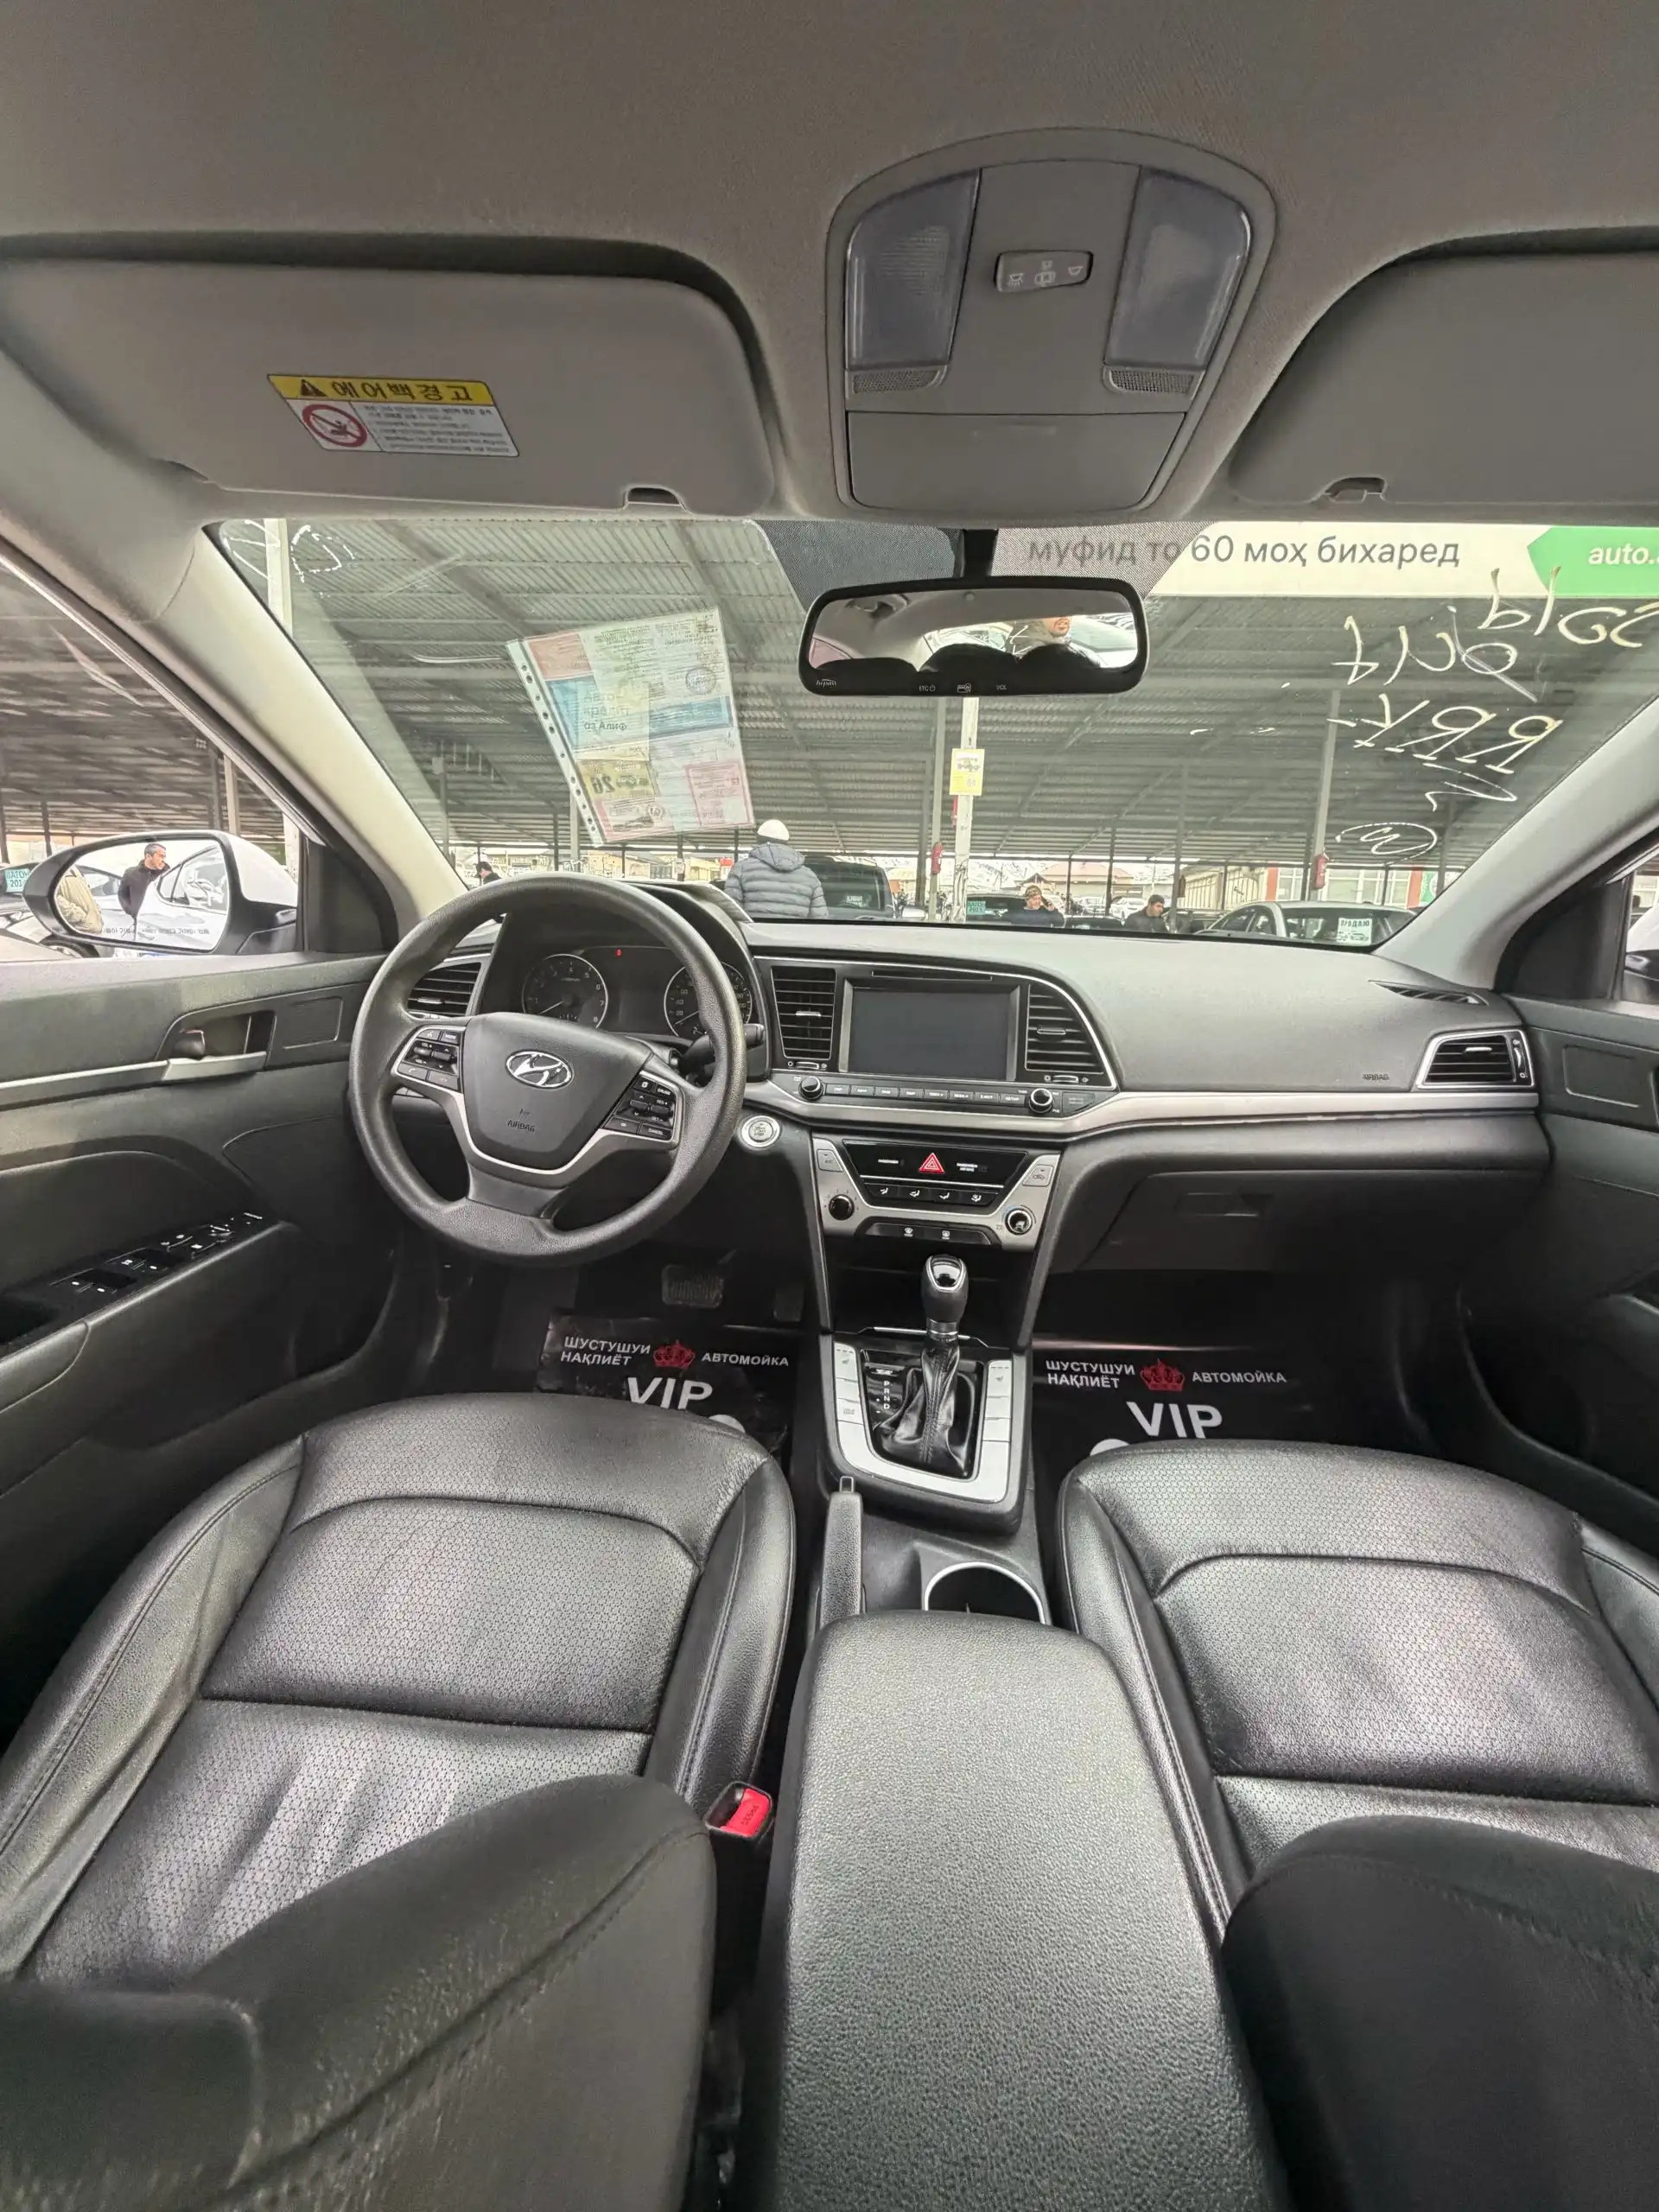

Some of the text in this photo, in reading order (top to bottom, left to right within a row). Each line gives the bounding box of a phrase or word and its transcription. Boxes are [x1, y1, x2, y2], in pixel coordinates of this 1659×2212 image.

[1192, 535, 1234, 562] 60
[1244, 543, 1307, 567] моҳ
[1318, 536, 1459, 570] бихаред
[563, 1336, 652, 1355] ШУСТУШУИ
[560, 1351, 632, 1366] НАҚЛИЁТ
[702, 1352, 789, 1367] АВТОМОЙКА
[1045, 1360, 1136, 1376] ШУСТУШУИ
[1192, 1370, 1287, 1383] АВТОМОЙКА
[1047, 1372, 1121, 1389] НАҚЛИЁТ
[626, 1376, 714, 1410] VIP
[1126, 1401, 1224, 1439] VIP
